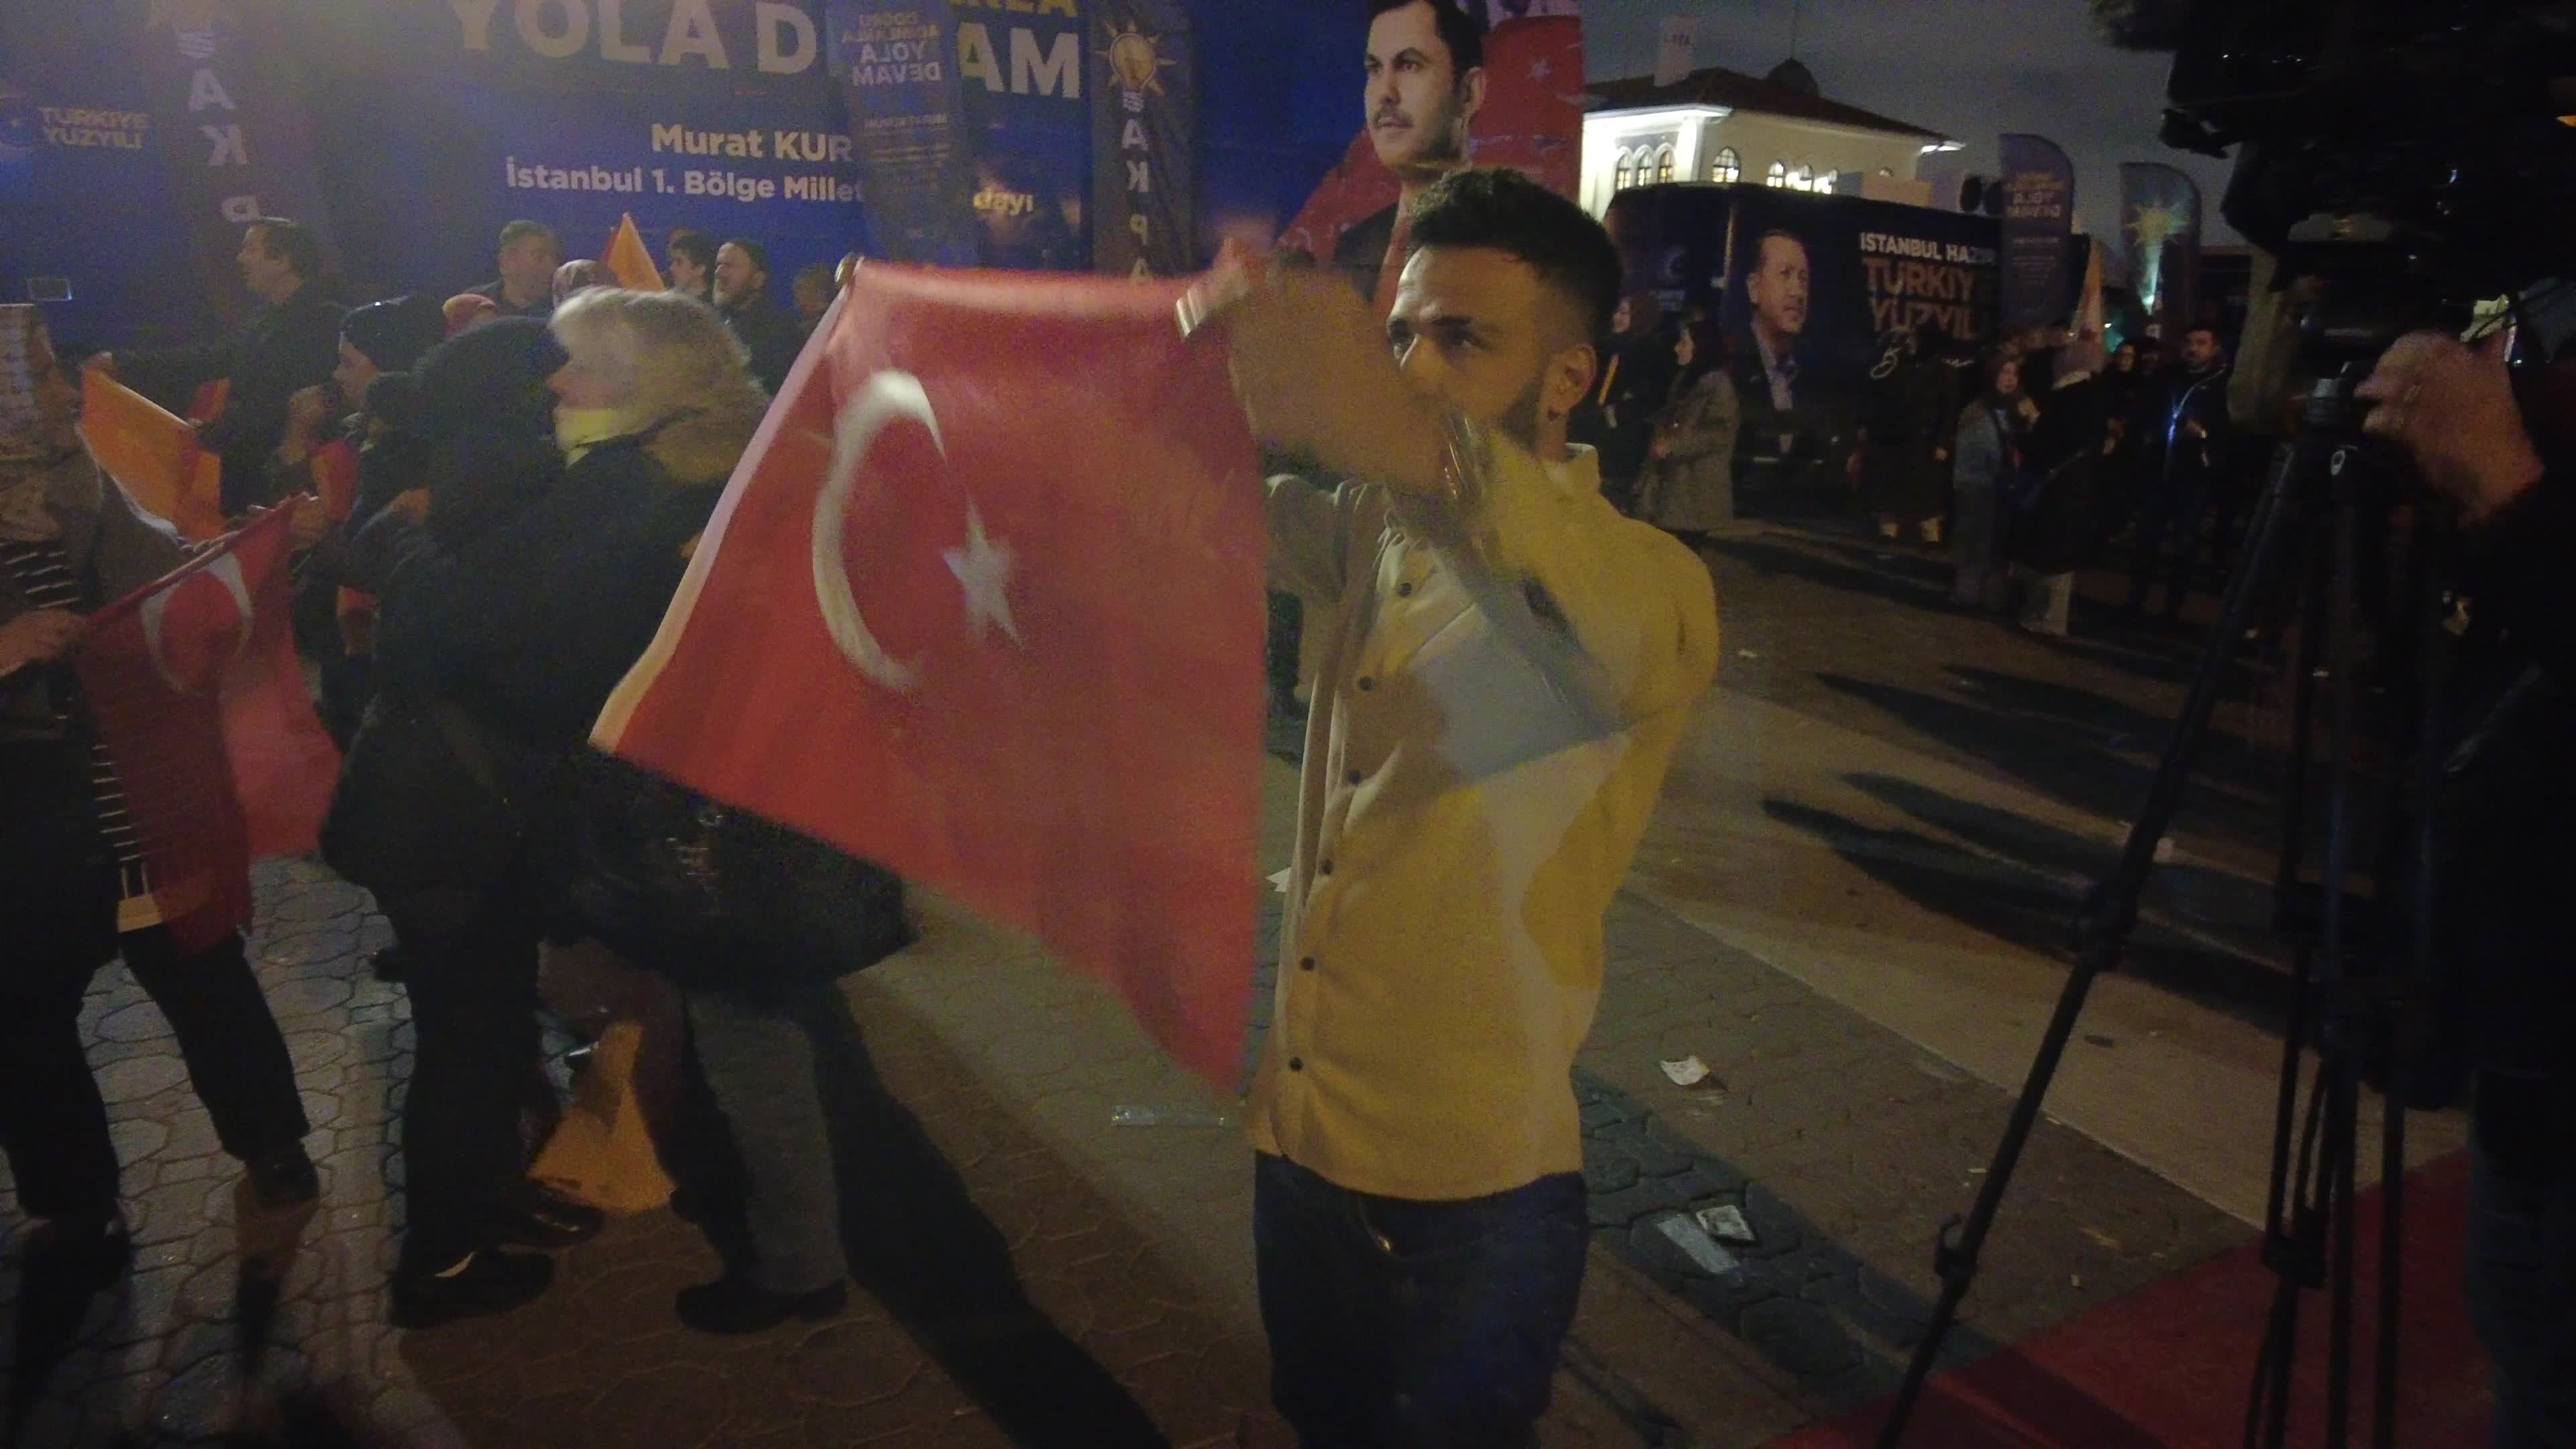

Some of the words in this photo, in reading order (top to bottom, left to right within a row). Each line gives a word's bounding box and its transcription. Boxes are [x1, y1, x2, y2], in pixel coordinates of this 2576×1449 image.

[447, 0, 731, 70] YOLA
[651, 123, 764, 158] Murat
[506, 155, 642, 193] İstanbul
[651, 169, 675, 193] 1.
[684, 170, 775, 202] Bölge
